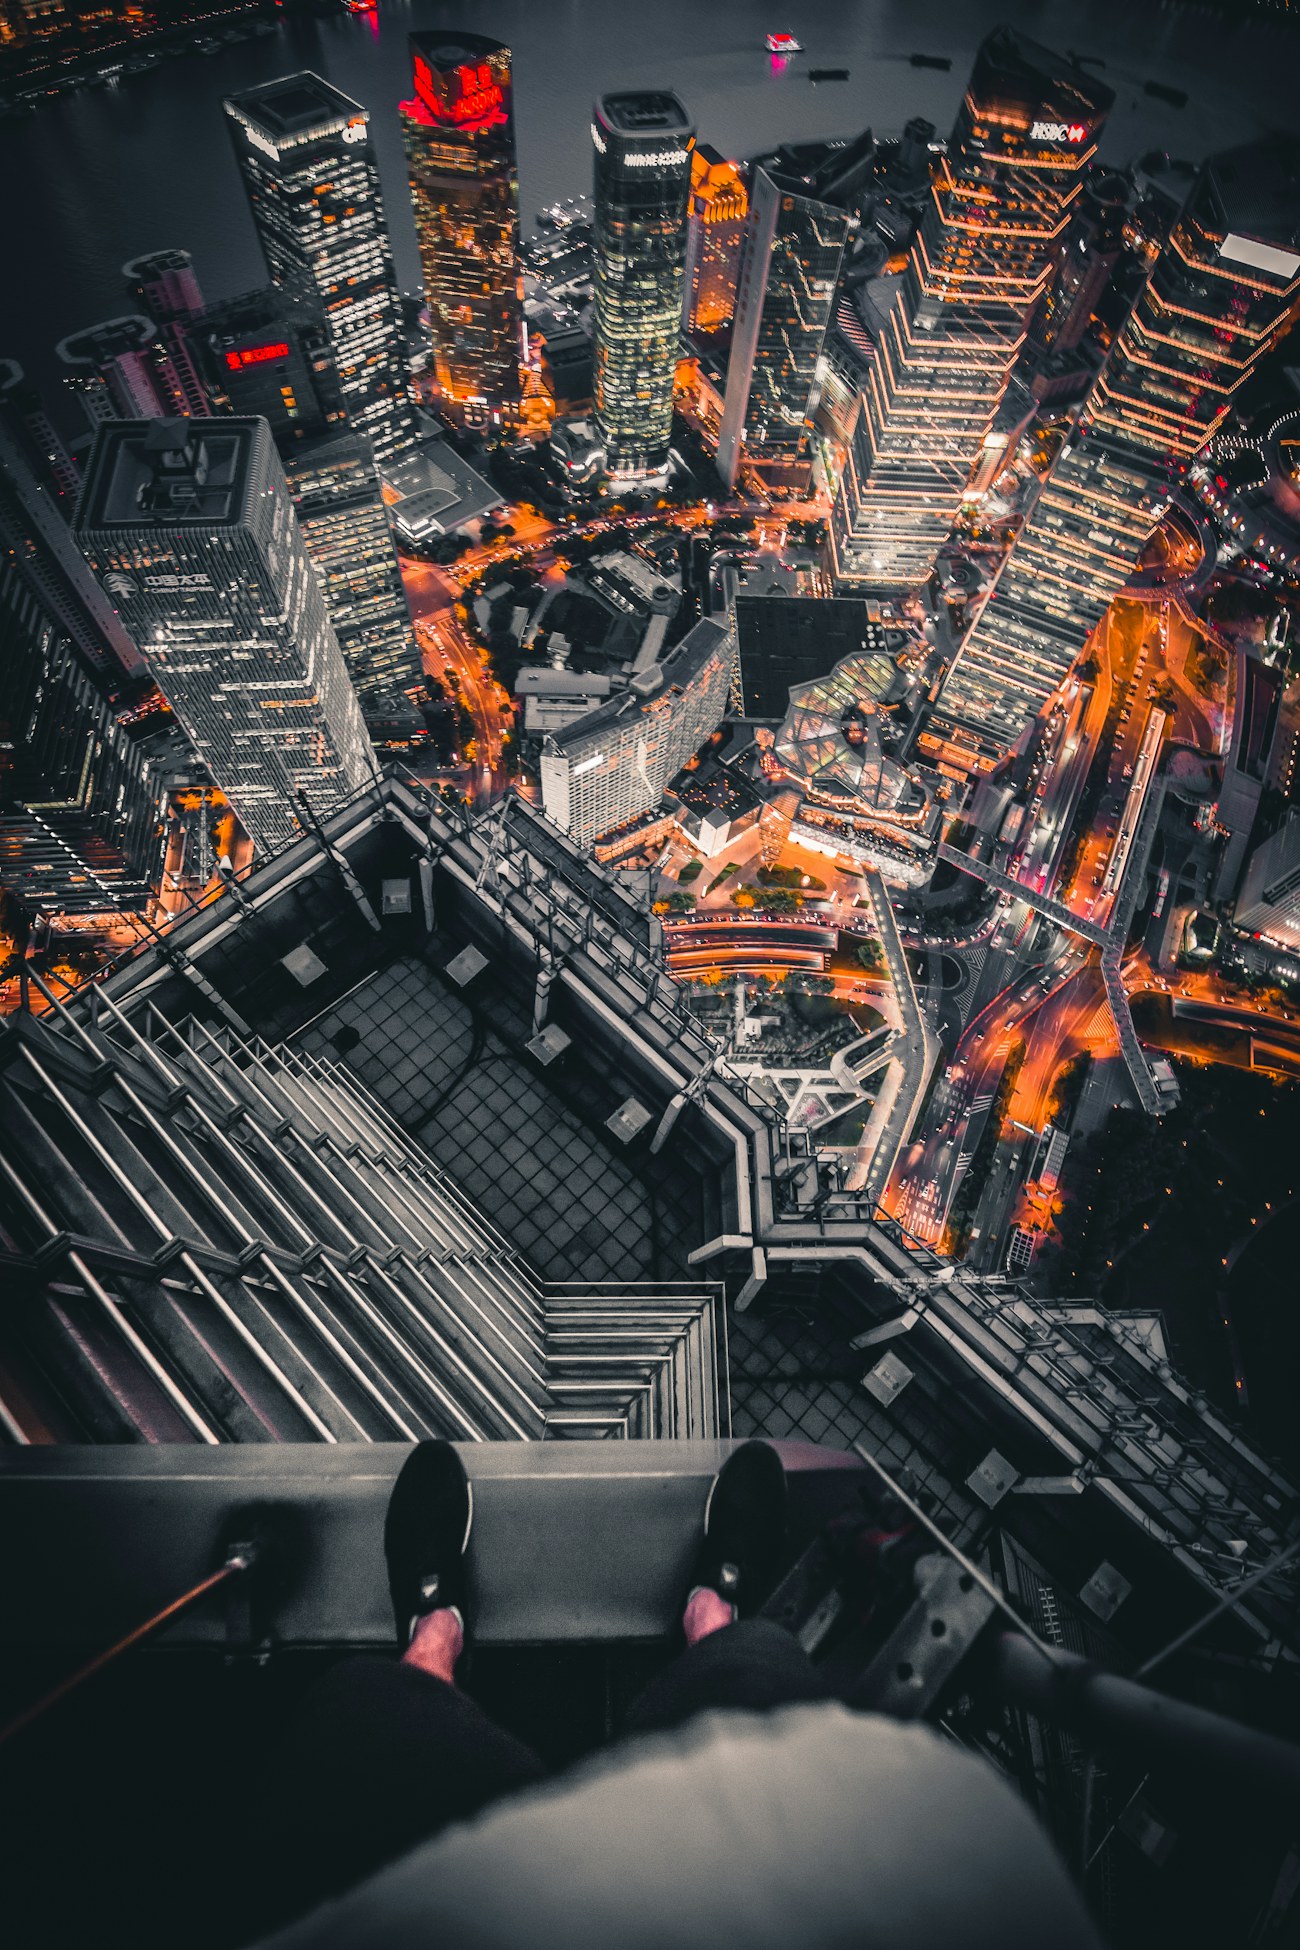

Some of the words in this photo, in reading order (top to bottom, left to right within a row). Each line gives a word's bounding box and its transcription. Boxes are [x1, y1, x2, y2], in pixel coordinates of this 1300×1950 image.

[1030, 122, 1069, 142] HSBC
[144, 573, 211, 586] 中国太平
